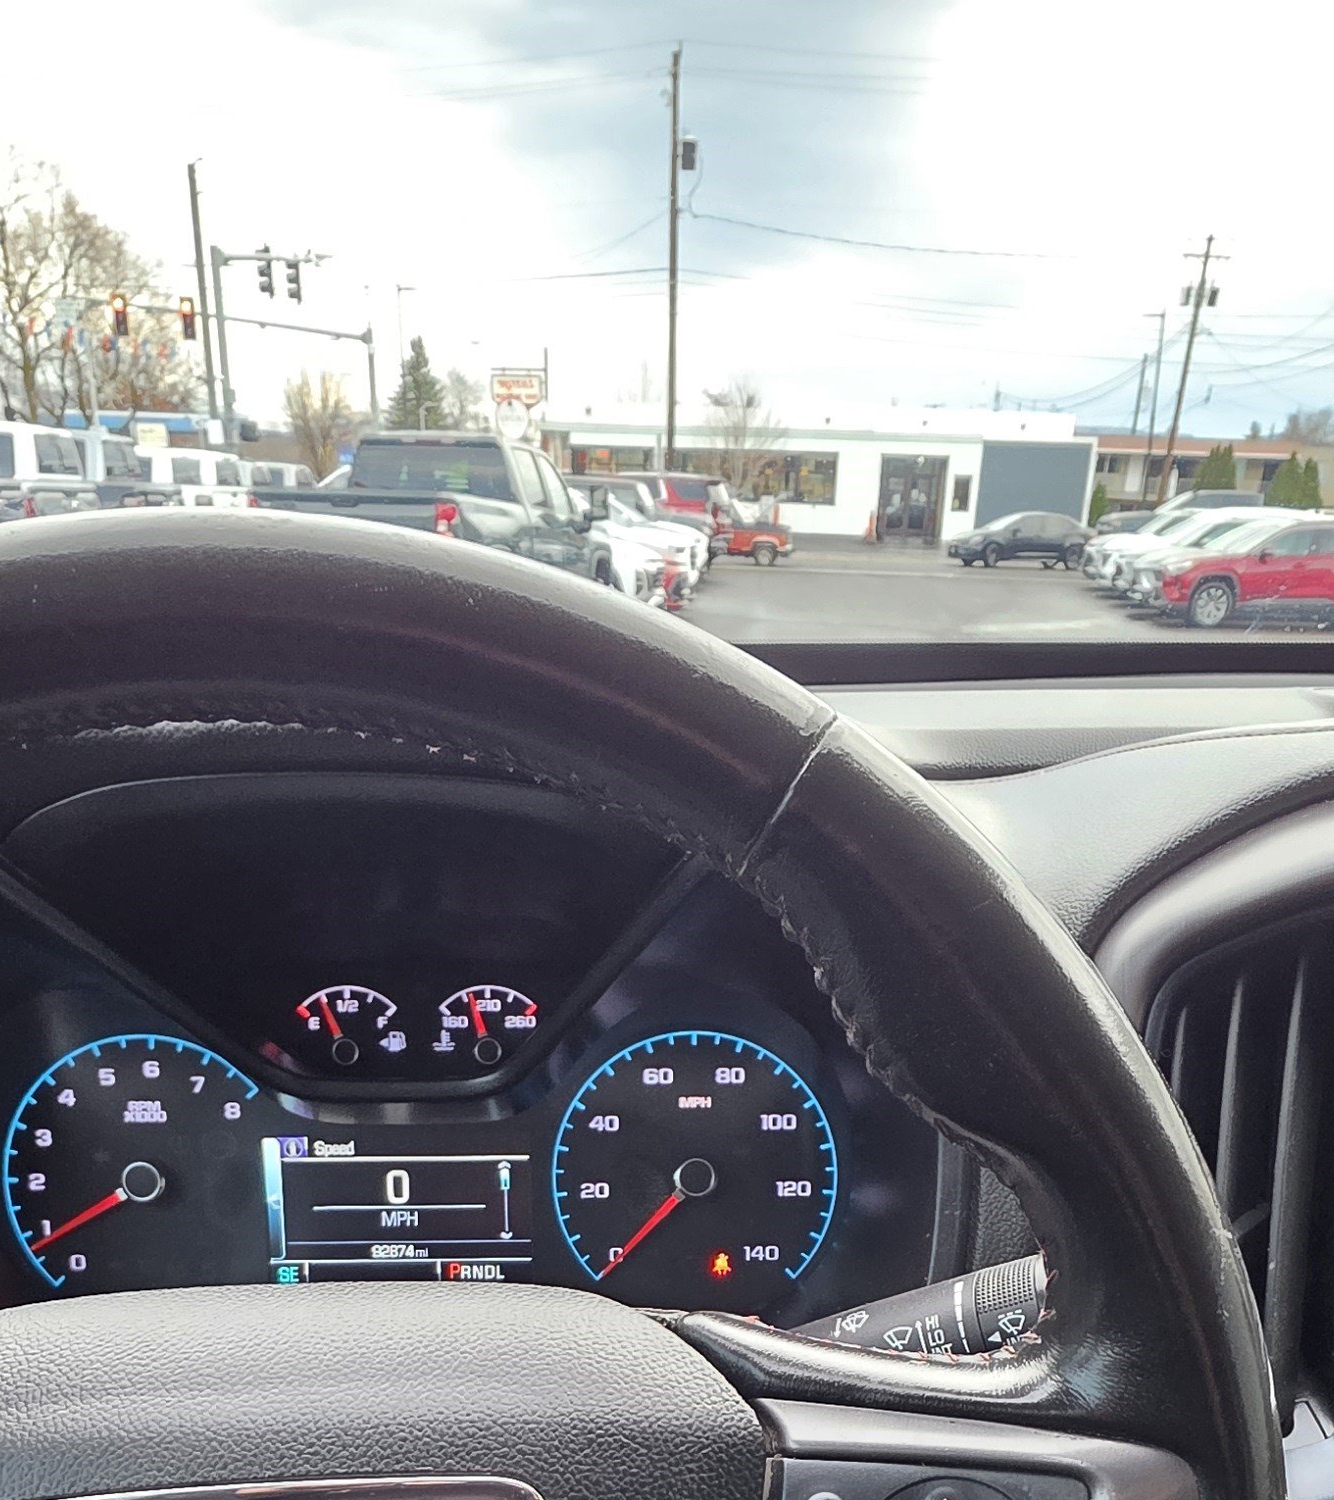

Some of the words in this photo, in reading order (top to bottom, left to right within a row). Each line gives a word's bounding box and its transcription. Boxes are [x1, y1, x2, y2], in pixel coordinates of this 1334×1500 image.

[336, 999, 359, 1013] 1/2
[475, 999, 501, 1012] 210
[307, 1016, 320, 1030] E
[377, 1016, 388, 1029] F
[442, 1016, 468, 1028] 160
[504, 1015, 537, 1028] 260
[98, 1068, 116, 1086] 5
[142, 1060, 160, 1078] 6
[642, 1067, 674, 1085] 60
[714, 1067, 746, 1084] 80
[189, 1076, 205, 1093] 7
[57, 1088, 76, 1107] 4
[127, 1100, 161, 1112] RPM
[678, 1096, 712, 1109] MPH
[223, 1102, 241, 1120] 8
[588, 1115, 620, 1132] 40
[759, 1114, 797, 1131] 100
[34, 1129, 53, 1147] 3
[313, 1139, 355, 1157] Speed
[28, 1173, 46, 1191] 2
[385, 1169, 410, 1204] 0
[579, 1182, 610, 1199] 20
[776, 1180, 811, 1197] 120
[381, 1211, 419, 1227] MPH
[41, 1220, 51, 1236] 1
[742, 1245, 780, 1262] 140
[69, 1254, 87, 1271] 0
[277, 1267, 299, 1283] SE
[449, 1263, 506, 1280] PRNDL
[925, 1314, 939, 1330] HI
[927, 1329, 945, 1347] LO
